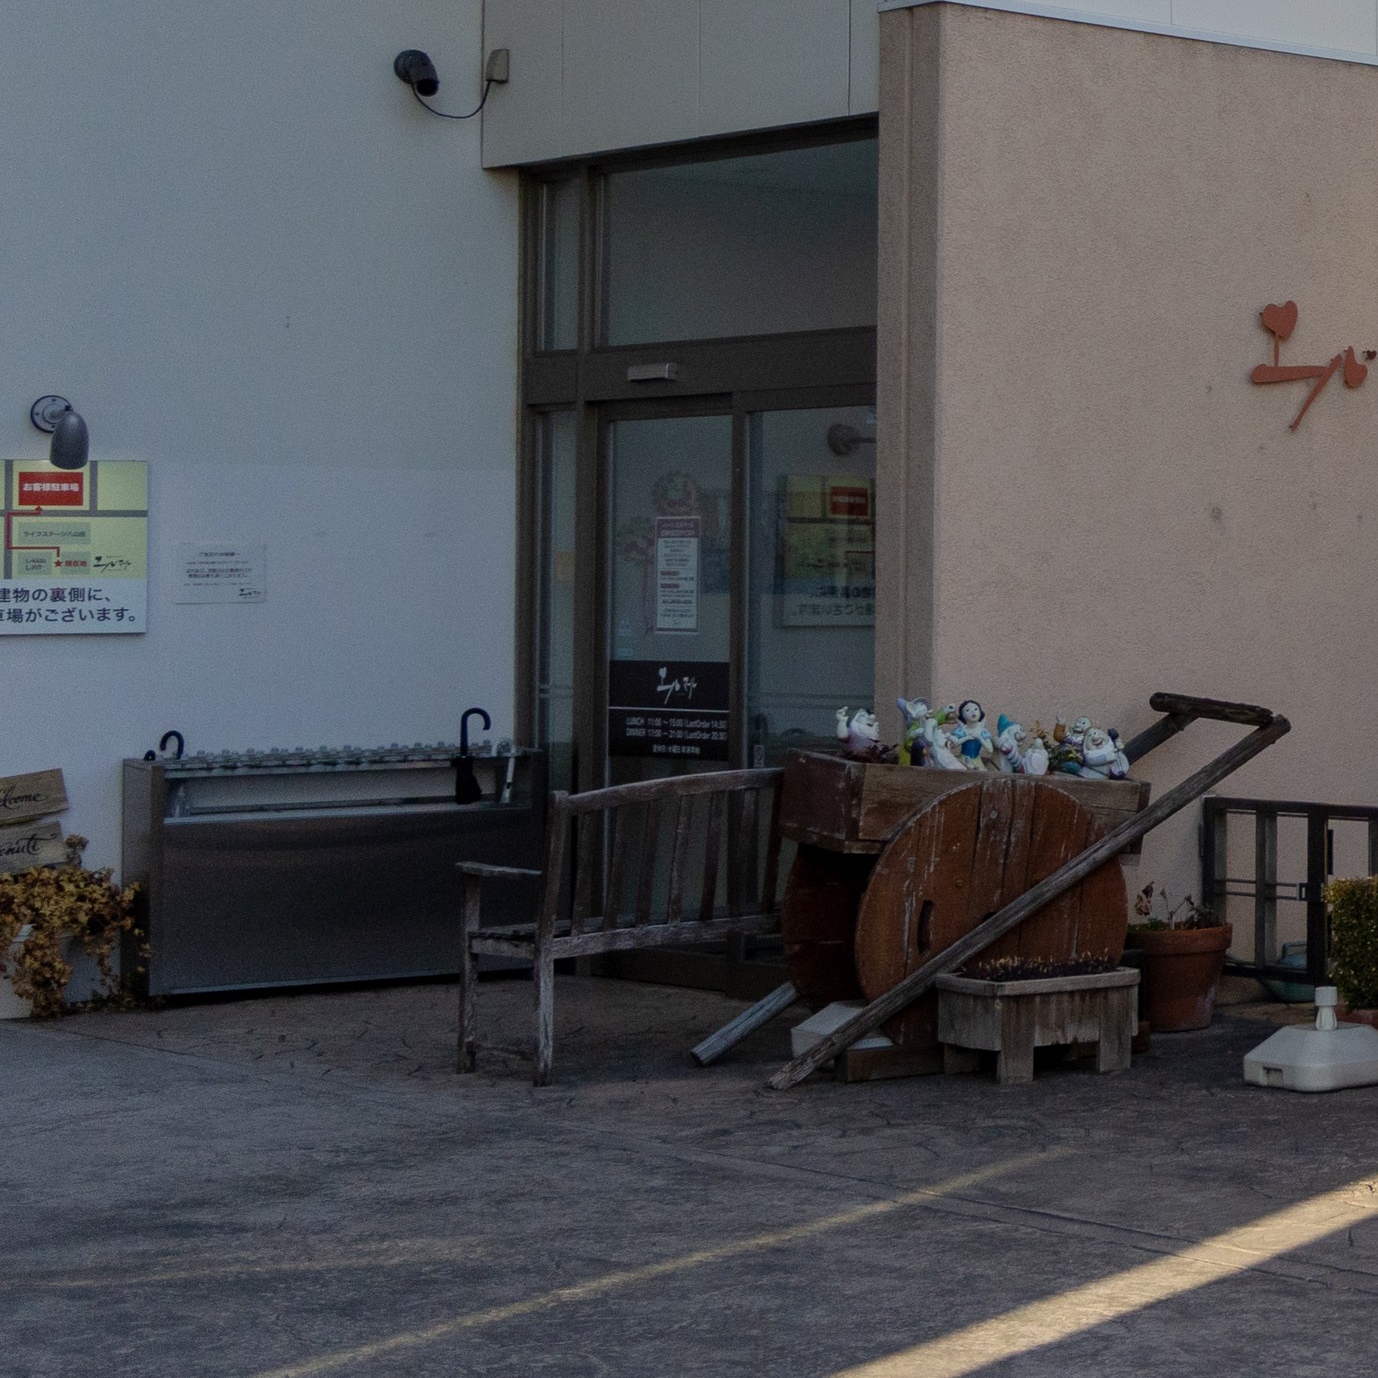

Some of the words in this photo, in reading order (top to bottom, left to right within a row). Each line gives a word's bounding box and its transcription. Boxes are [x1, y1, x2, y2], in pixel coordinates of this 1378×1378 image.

[0, 607, 136, 623] 場がございます。
